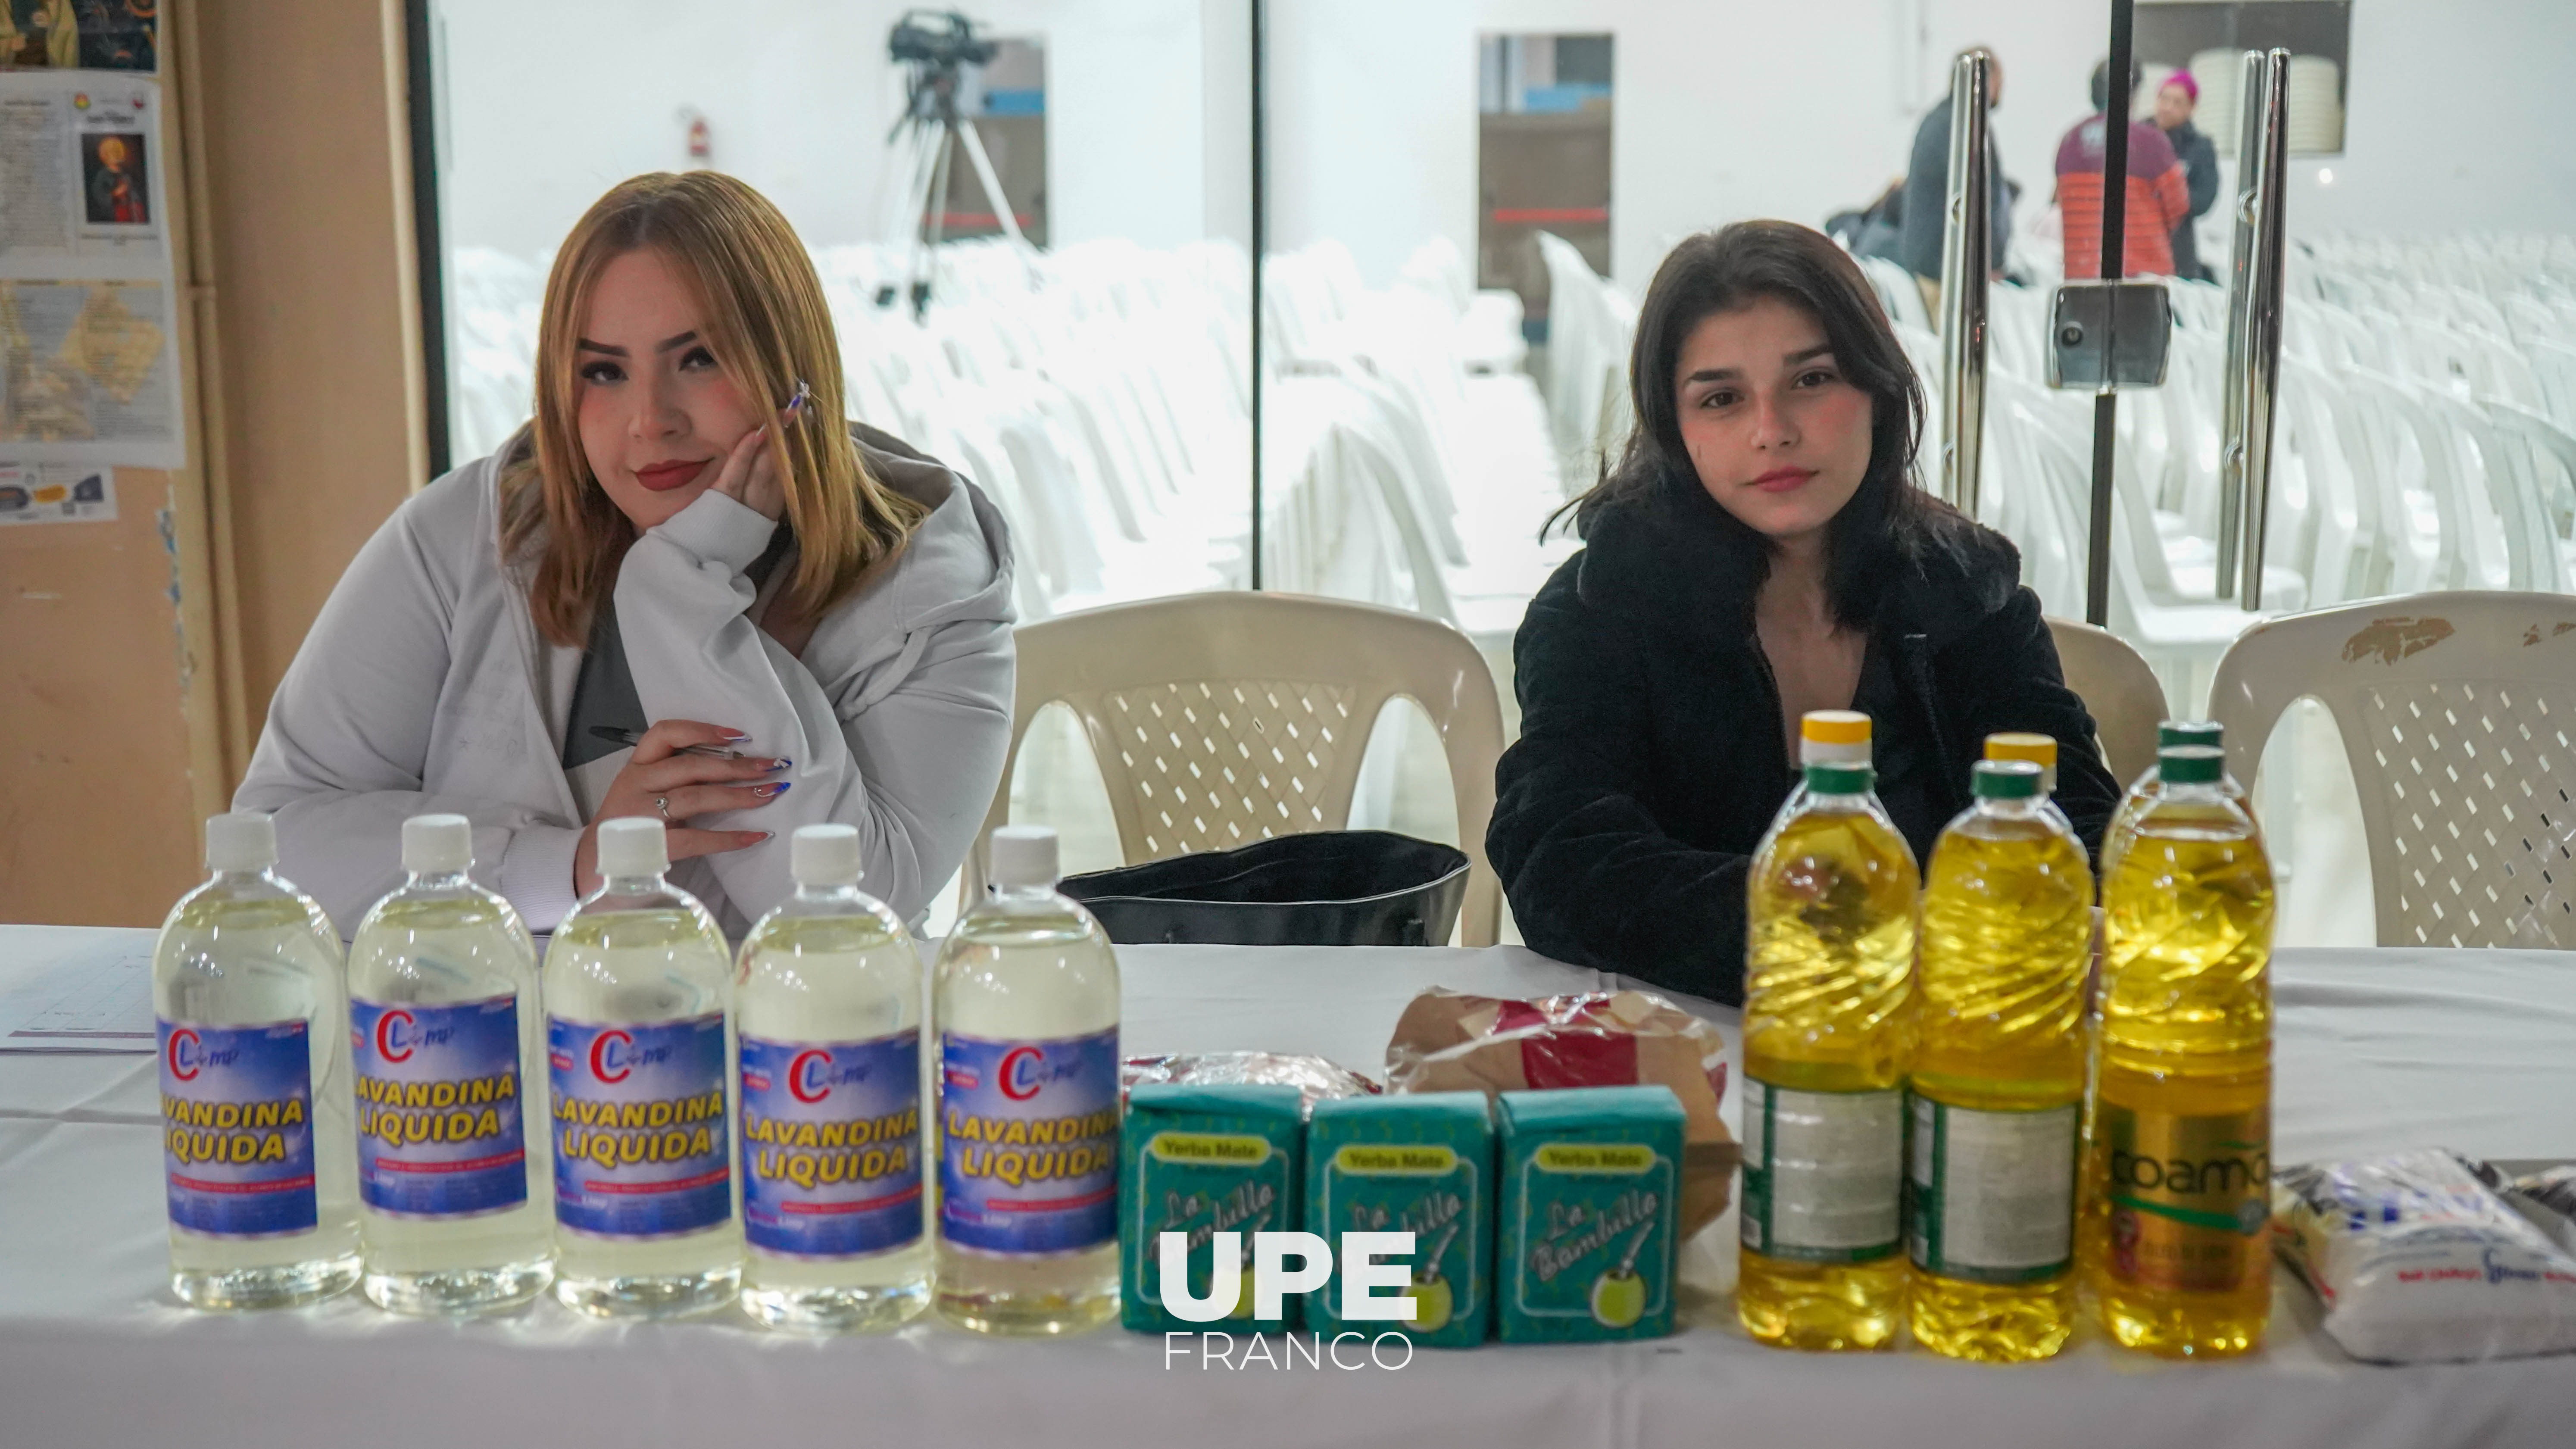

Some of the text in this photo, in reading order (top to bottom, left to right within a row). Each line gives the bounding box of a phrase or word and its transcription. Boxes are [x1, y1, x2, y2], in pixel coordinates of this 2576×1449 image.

[356, 1073, 515, 1108] AVANDINA
[553, 1091, 723, 1127] LAVANDINA
[161, 1093, 304, 1129] VANDINA
[359, 1106, 499, 1147] LIQUIDA
[745, 1109, 919, 1148] LAVANDINA
[166, 1127, 285, 1165] IQUIDA
[564, 1127, 711, 1169] LIQUIDA
[963, 1141, 1109, 1186] LIQUIDA
[1164, 1140, 1258, 1159] Yerba Mate
[1349, 1152, 1444, 1168] Yerba Mate
[1548, 1150, 1642, 1168] Yerba Mate
[759, 1145, 908, 1189] LIQUIDA
